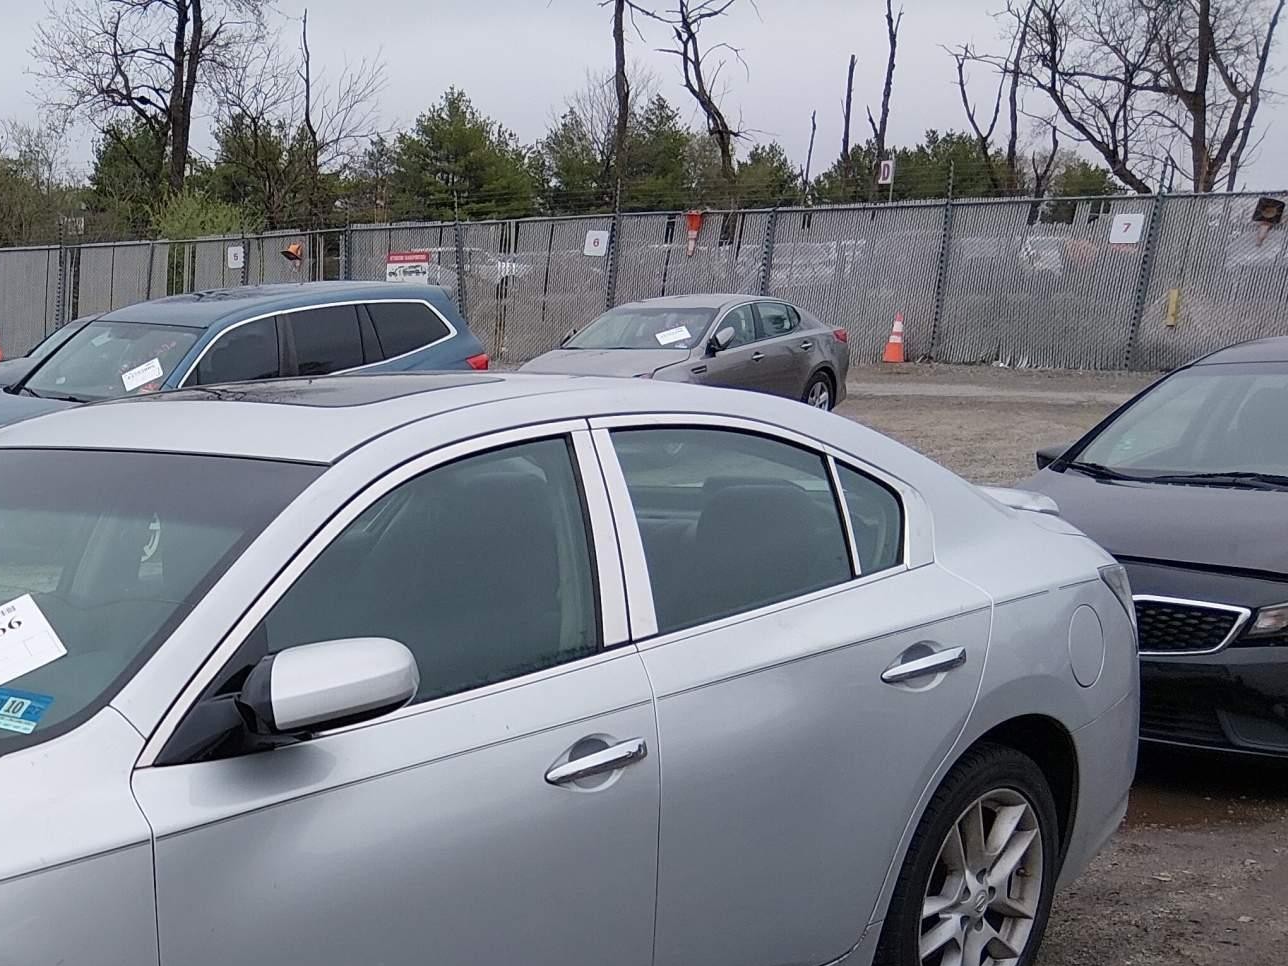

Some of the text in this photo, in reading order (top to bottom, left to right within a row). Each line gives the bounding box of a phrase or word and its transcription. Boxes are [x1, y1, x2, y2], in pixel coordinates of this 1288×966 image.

[881, 163, 891, 182] D
[1122, 223, 1132, 233] 7
[5, 699, 25, 714] 10
